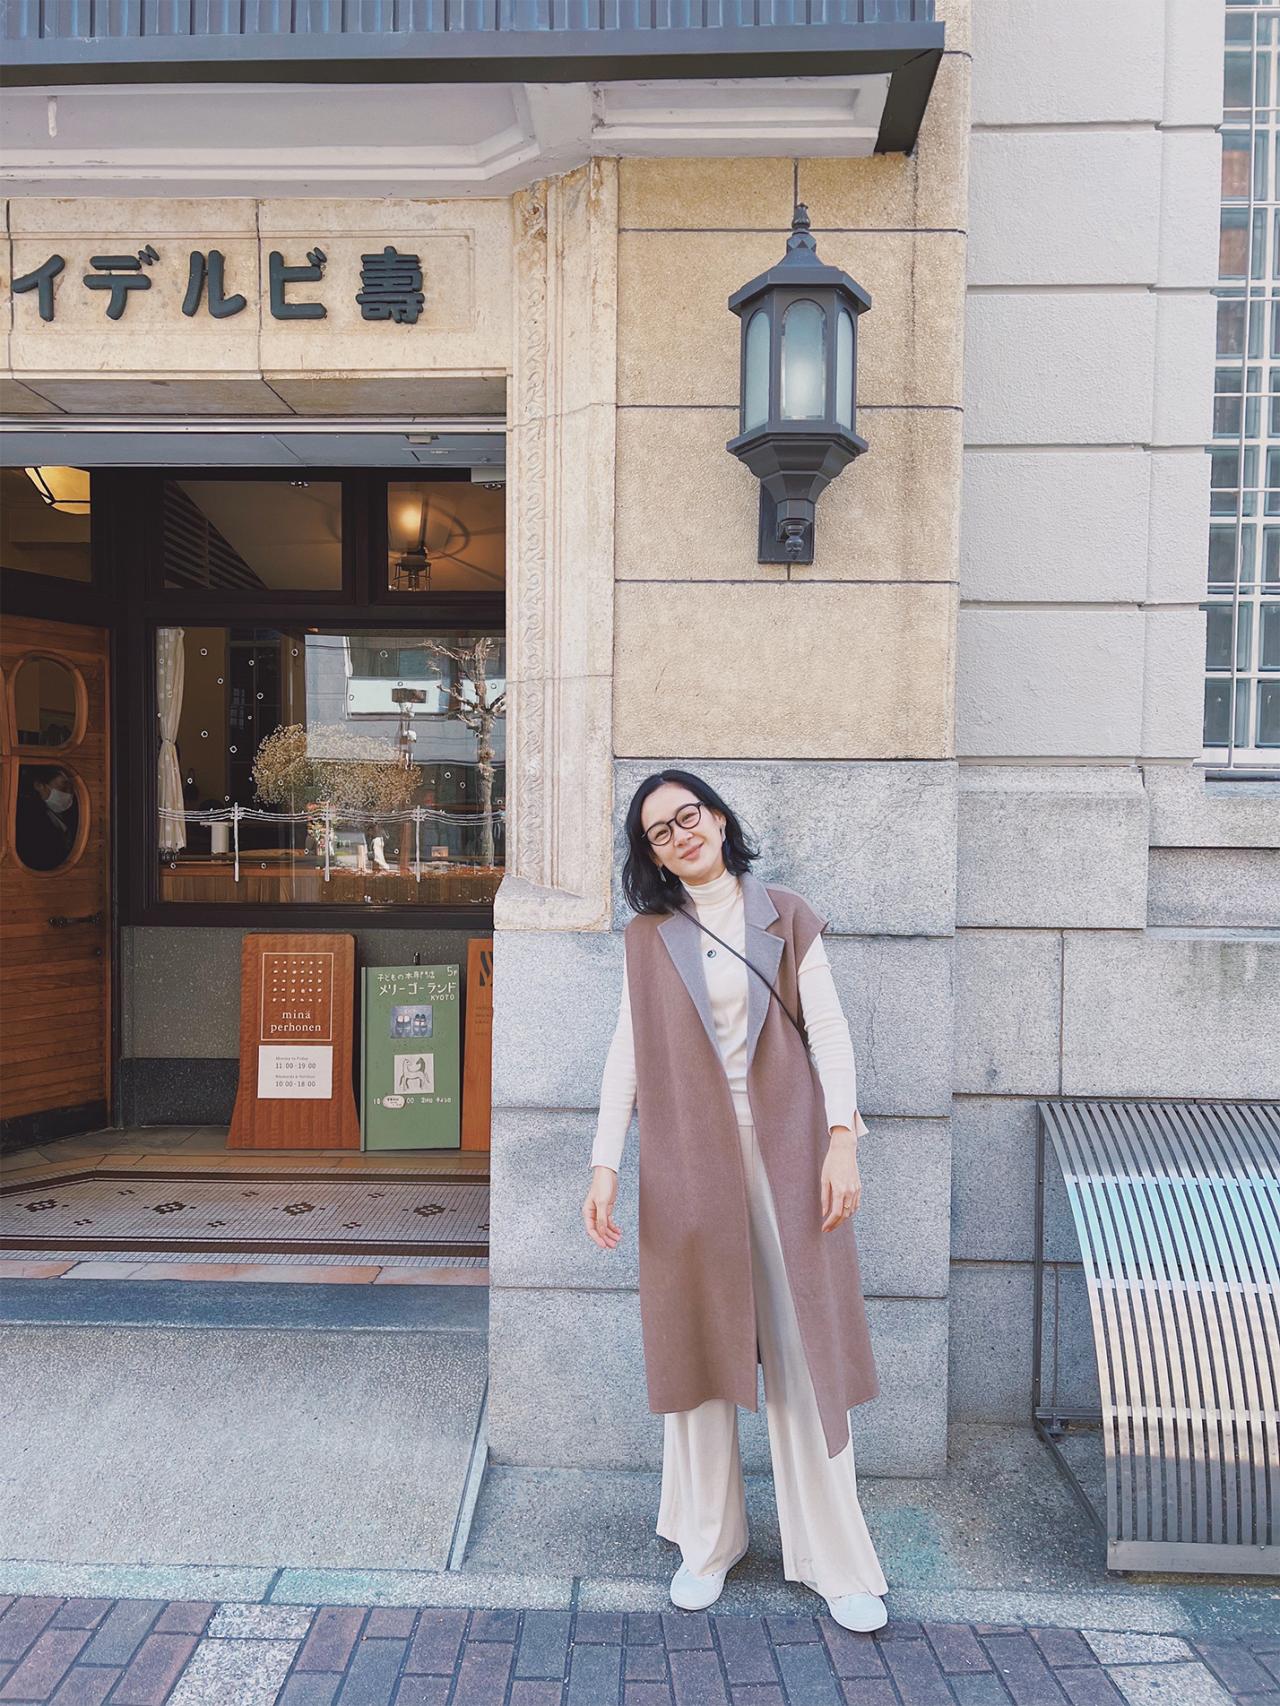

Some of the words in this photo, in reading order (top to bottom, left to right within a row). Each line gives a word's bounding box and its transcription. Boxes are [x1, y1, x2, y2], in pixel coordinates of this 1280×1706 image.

[379, 982, 457, 996] メリーゴーランド
[270, 1022, 321, 1033] perhonen
